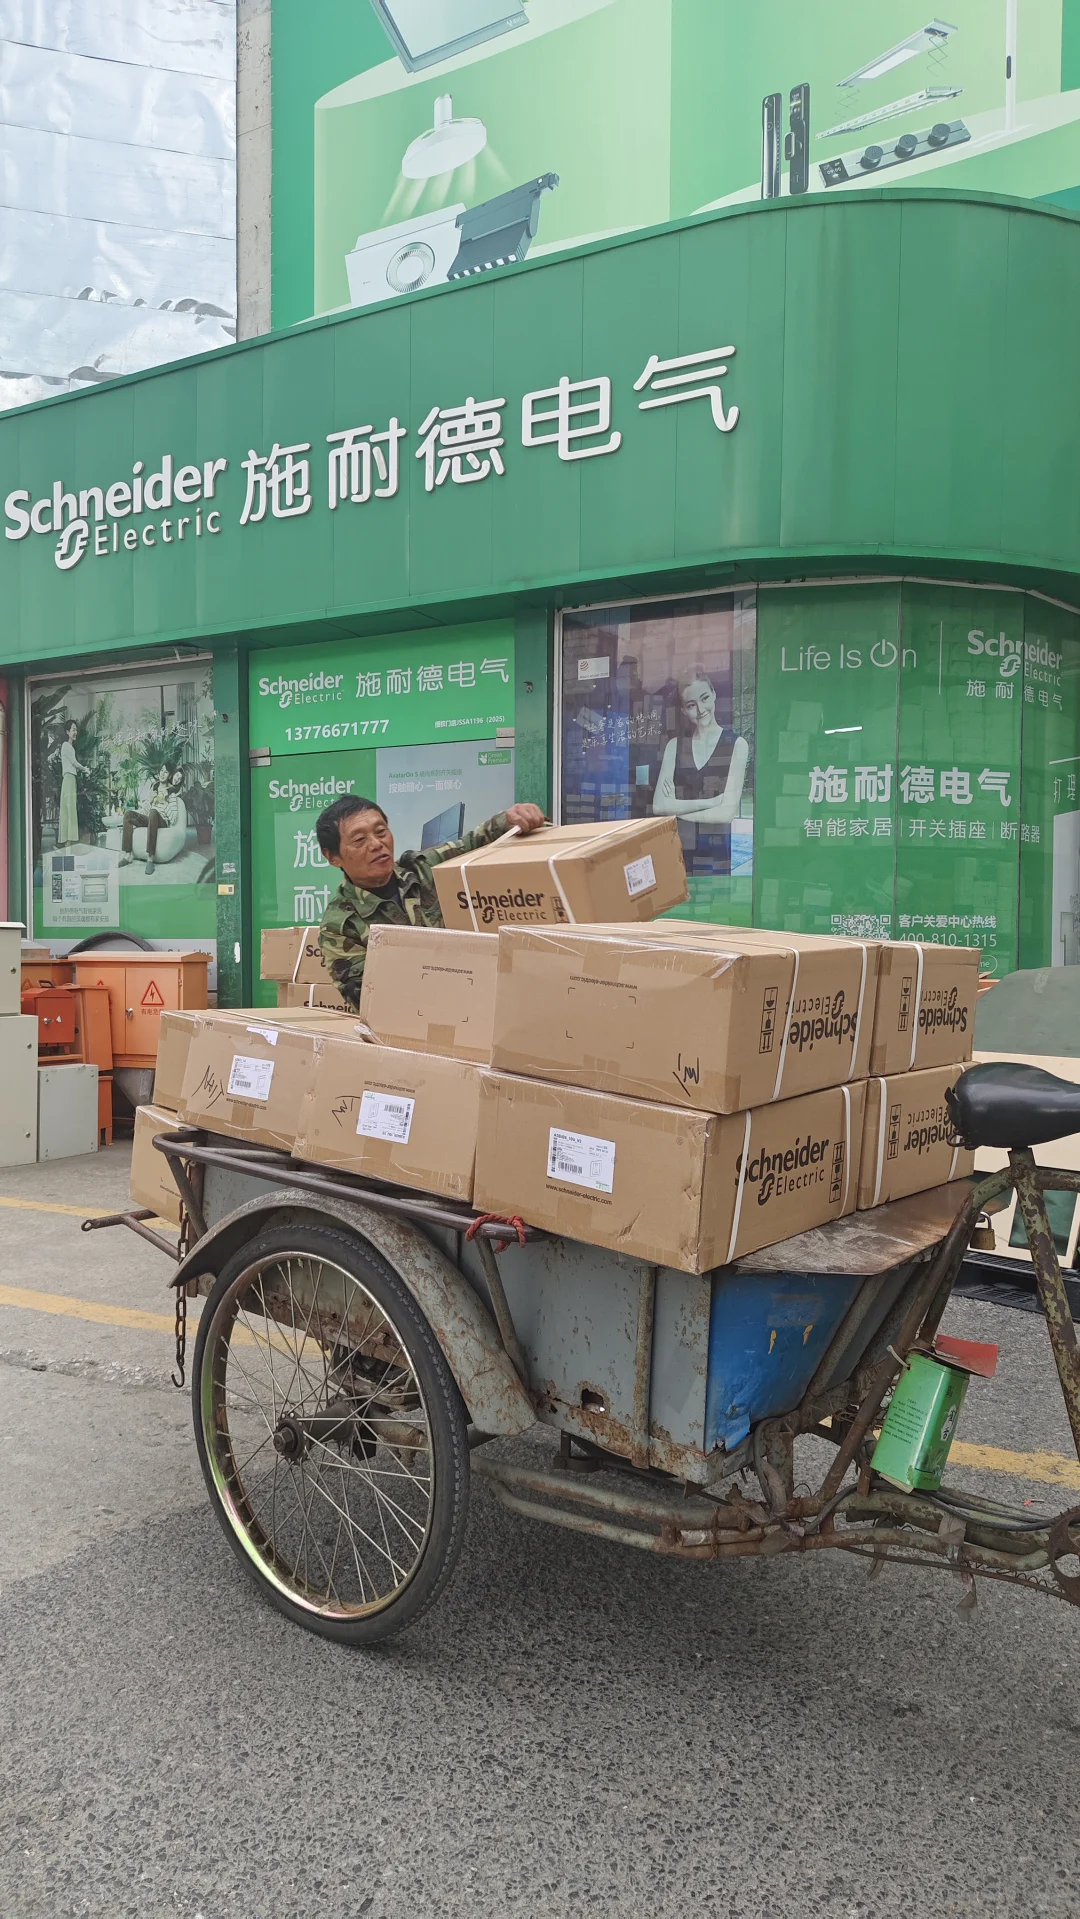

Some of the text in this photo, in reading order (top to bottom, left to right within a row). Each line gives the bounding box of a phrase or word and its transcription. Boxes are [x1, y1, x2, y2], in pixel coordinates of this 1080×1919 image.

[239, 344, 741, 526] 施耐德电气
[4, 453, 229, 541] Schneider
[93, 507, 223, 557] Electric
[781, 645, 831, 672] Life
[840, 644, 862, 669] Is
[968, 629, 1063, 669] Schneider
[258, 671, 345, 698] Schneider
[355, 657, 510, 698] 施耐德电气
[1024, 662, 1061, 688] Electric
[294, 691, 343, 706] Electric
[966, 679, 1063, 711] 施耐德电气
[284, 718, 390, 741] 13776671777
[268, 776, 356, 799] Schneider
[808, 764, 1012, 807] 施耐德电气
[804, 817, 1041, 844] 智能家居 开关插座 断路器
[457, 888, 545, 910] Schneider
[496, 909, 547, 921] Electric
[899, 914, 997, 929] 客户关爱中心热线
[899, 932, 997, 948] 400-810-1315
[569, 975, 638, 991] www.schneider-electric.com
[907, 1106, 943, 1127] Electric
[734, 1135, 829, 1186] Schneider
[545, 1183, 613, 1207] www.schneider-electric.com
[776, 1166, 825, 1197] Electric
